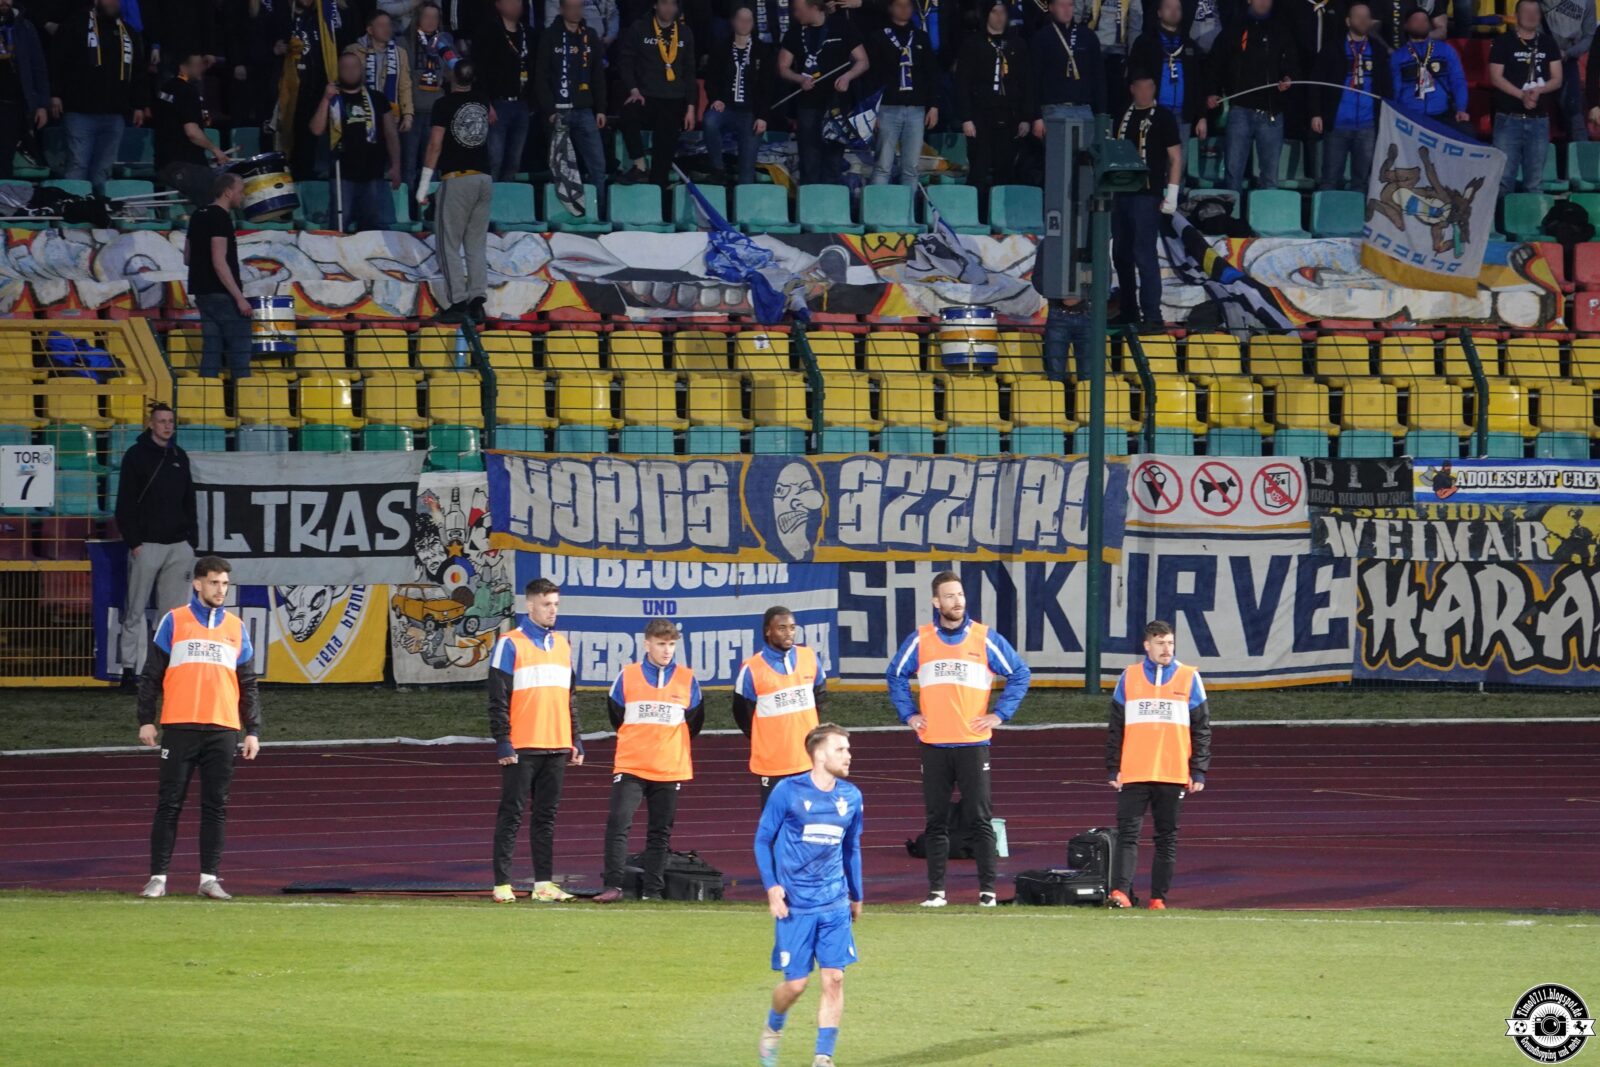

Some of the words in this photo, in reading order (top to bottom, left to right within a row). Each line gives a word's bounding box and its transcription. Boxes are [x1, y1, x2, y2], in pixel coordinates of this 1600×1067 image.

[14, 451, 40, 464] TOR
[20, 475, 36, 500] 7
[1455, 469, 1559, 488] ADOLESCENT
[1320, 516, 1553, 562] WEIMAR
[643, 599, 677, 616] UND
[1362, 561, 1600, 661] HARA
